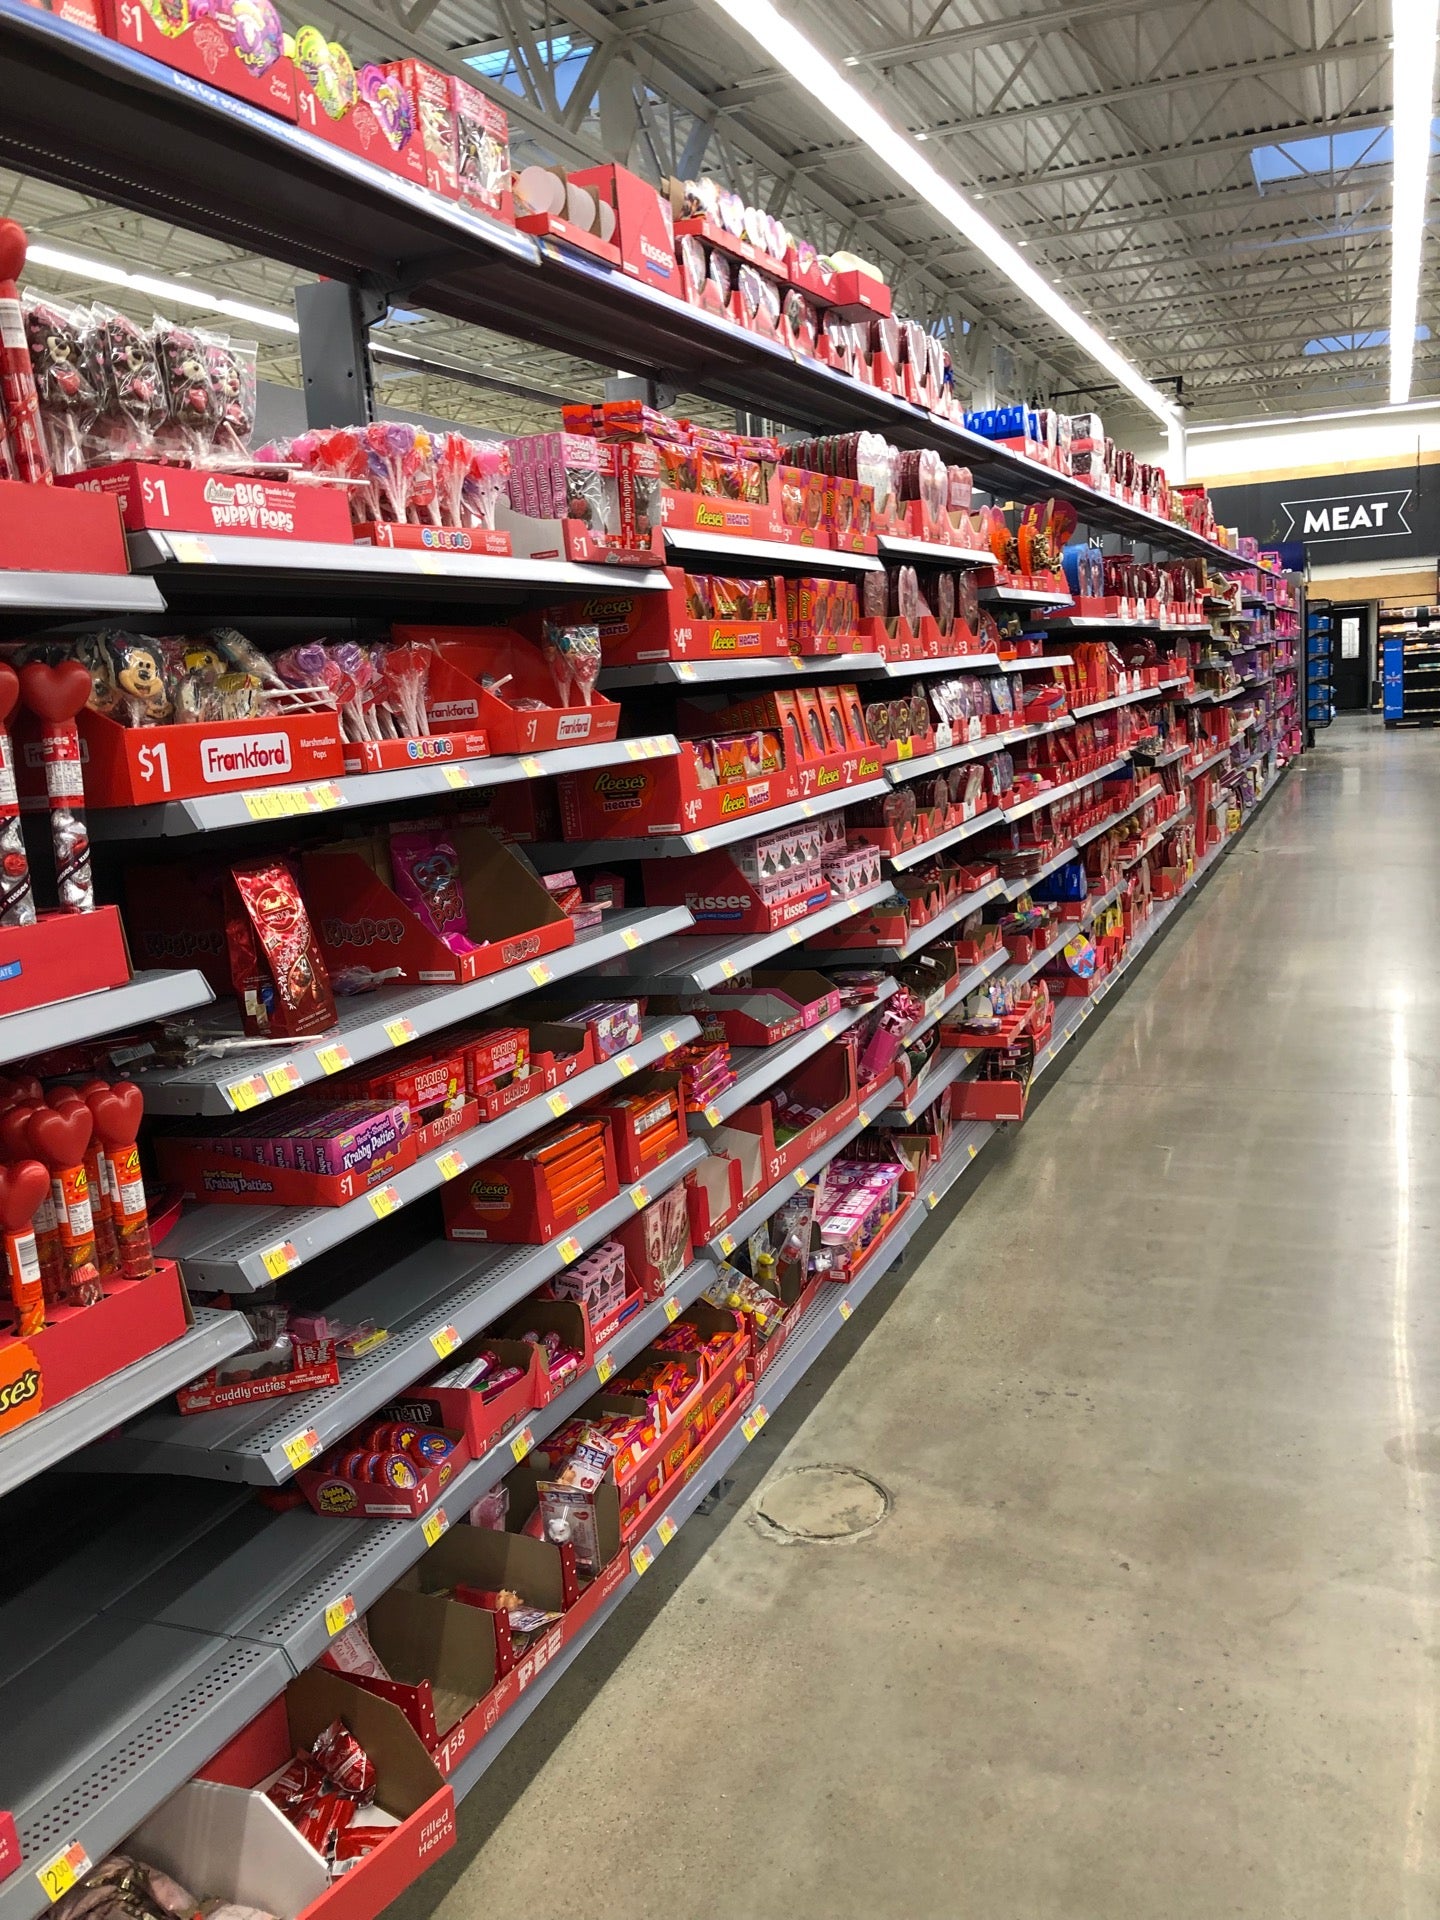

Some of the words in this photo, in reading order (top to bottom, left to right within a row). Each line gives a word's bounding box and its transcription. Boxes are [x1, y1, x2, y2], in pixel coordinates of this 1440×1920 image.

[121, 3, 143, 42] $1
[300, 93, 317, 126] $1
[427, 170, 441, 191] $1
[142, 477, 170, 517] $1
[235, 483, 265, 507] BIG
[211, 507, 259, 529] PUPPY
[260, 508, 294, 533] POPS
[696, 503, 723, 528] Reese's
[1303, 502, 1389, 534] MEAT
[377, 524, 395, 548] $1
[422, 528, 472, 550] Galerie
[573, 537, 588, 557] $1
[712, 629, 736, 651] Reese's
[526, 719, 537, 743] $1
[560, 718, 590, 735] Frankford
[300, 736, 337, 748] Marshmallow
[406, 738, 454, 760] Galerie
[138, 742, 171, 793] $1
[208, 739, 286, 773] Frankford
[313, 751, 327, 760] Pops
[367, 742, 383, 769] $1
[595, 773, 647, 792] Reese's
[722, 792, 746, 814] Reese's
[463, 956, 476, 977] $1
[491, 1039, 517, 1060] HARIBO
[415, 1067, 449, 1091] HARIBO
[547, 1067, 557, 1085] $1
[491, 1098, 498, 1111] $1
[504, 1082, 531, 1106] HARIBO
[433, 1110, 463, 1136] HARIBO
[419, 1129, 427, 1144] $1
[343, 1143, 372, 1170] Krabby
[371, 1128, 395, 1153] Patties
[204, 1177, 239, 1194] Krabby
[240, 1177, 273, 1192] Patties
[340, 1175, 353, 1196] $1
[471, 1180, 509, 1196] Reese's
[215, 1386, 250, 1403] cuddly
[252, 1379, 286, 1395] cuties
[480, 1439, 487, 1452] $1
[577, 1444, 608, 1469] PEZ
[416, 1483, 428, 1504] $1
[518, 1628, 561, 1692] PEZ
[434, 1728, 466, 1773] $158
[420, 1808, 449, 1843] Filled
[418, 1820, 453, 1858] Hearts
